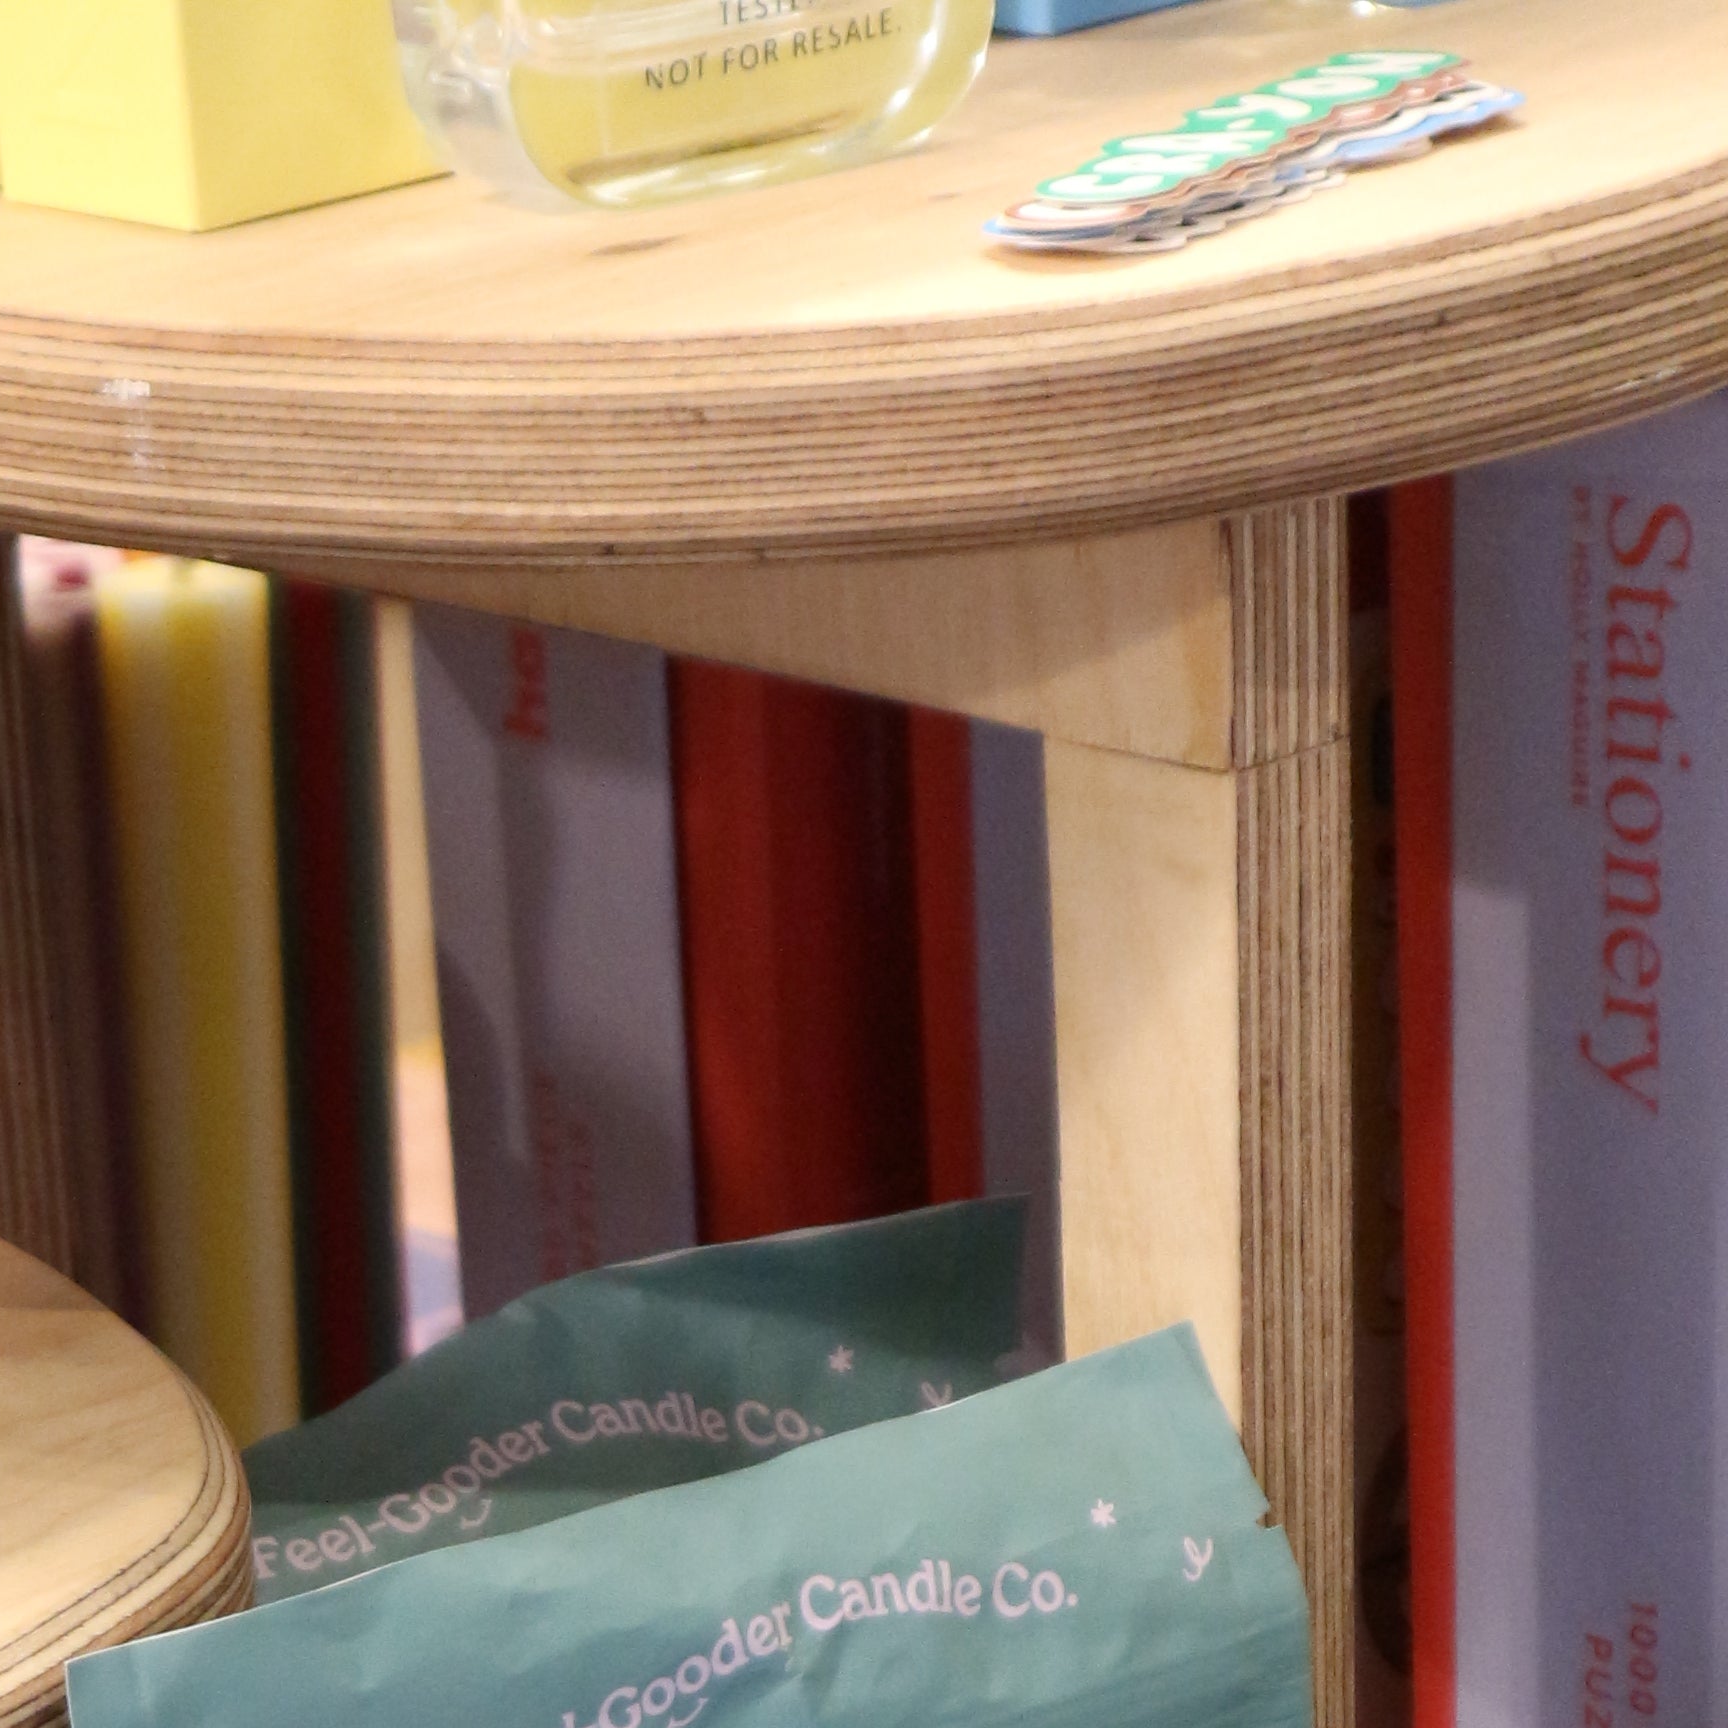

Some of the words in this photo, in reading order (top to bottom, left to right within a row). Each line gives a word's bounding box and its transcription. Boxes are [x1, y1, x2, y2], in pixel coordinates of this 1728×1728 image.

[645, 52, 707, 89] NOT
[722, 38, 779, 74] FOR
[793, 7, 902, 58] RESALE.
[1579, 496, 1692, 1116] Stationery
[252, 1418, 552, 1580] Feel-Gooder
[551, 1392, 729, 1444] Candle
[734, 1399, 824, 1447] Co.
[799, 1558, 982, 1632] Candle
[991, 1561, 1080, 1620] Co.
[1630, 1601, 1659, 1716] 1000
